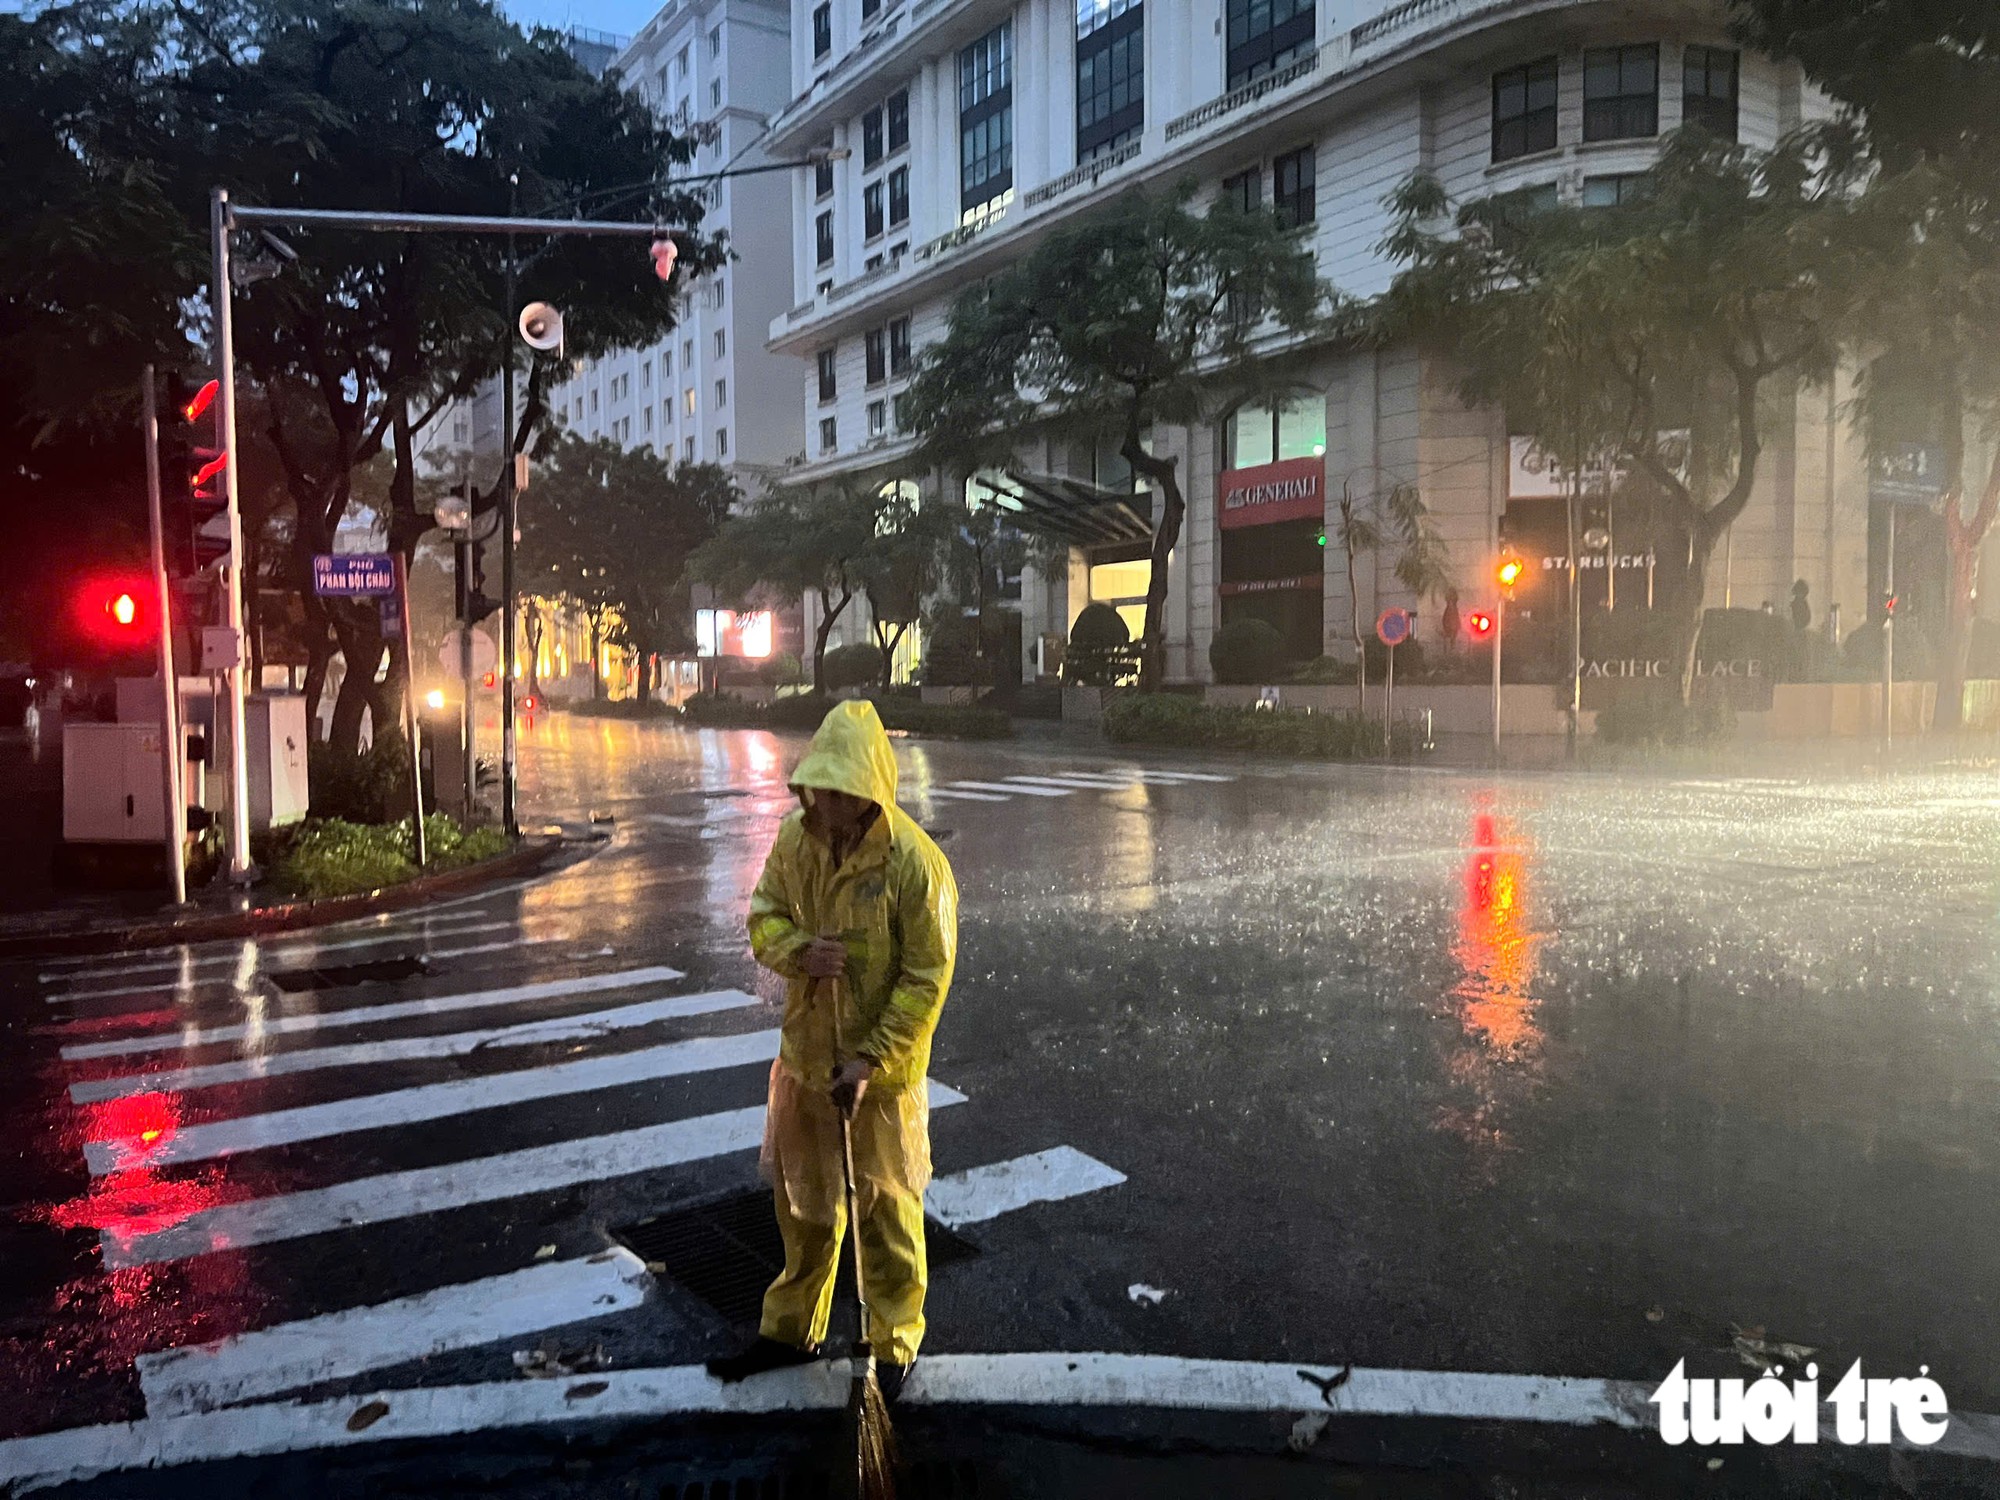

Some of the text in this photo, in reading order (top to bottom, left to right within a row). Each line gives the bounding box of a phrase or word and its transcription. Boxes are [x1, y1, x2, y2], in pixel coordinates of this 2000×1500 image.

[1246, 475, 1316, 505] GENERALI
[1568, 657, 1762, 679] PACIFIC LACE
